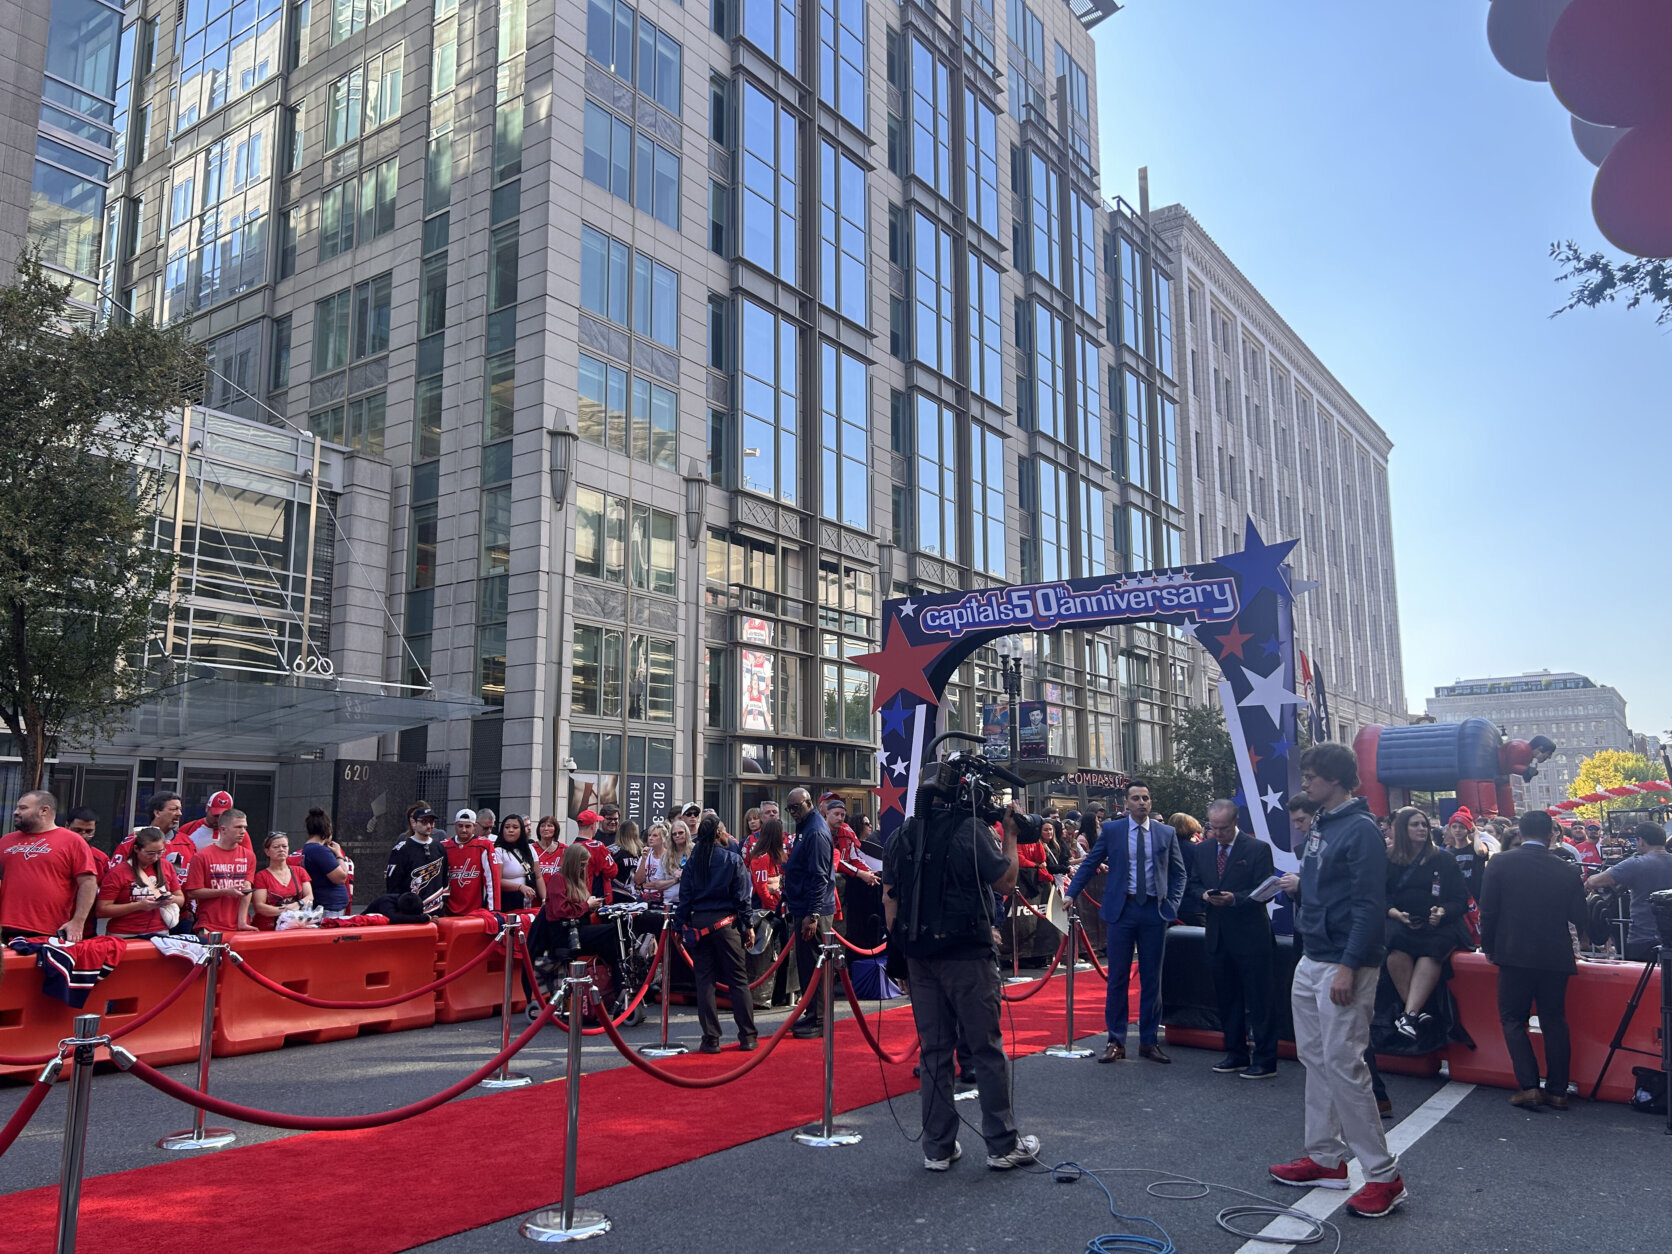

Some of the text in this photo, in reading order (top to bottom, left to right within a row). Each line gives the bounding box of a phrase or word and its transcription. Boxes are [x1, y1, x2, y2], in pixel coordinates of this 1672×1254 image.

[926, 597, 1013, 630] capitals
[1059, 583, 1235, 615] anniversary
[293, 655, 334, 675] 620
[344, 764, 370, 780] 620
[1067, 772, 1114, 787] COMPASS
[629, 782, 641, 820] RETAIL
[755, 870, 768, 883] 70
